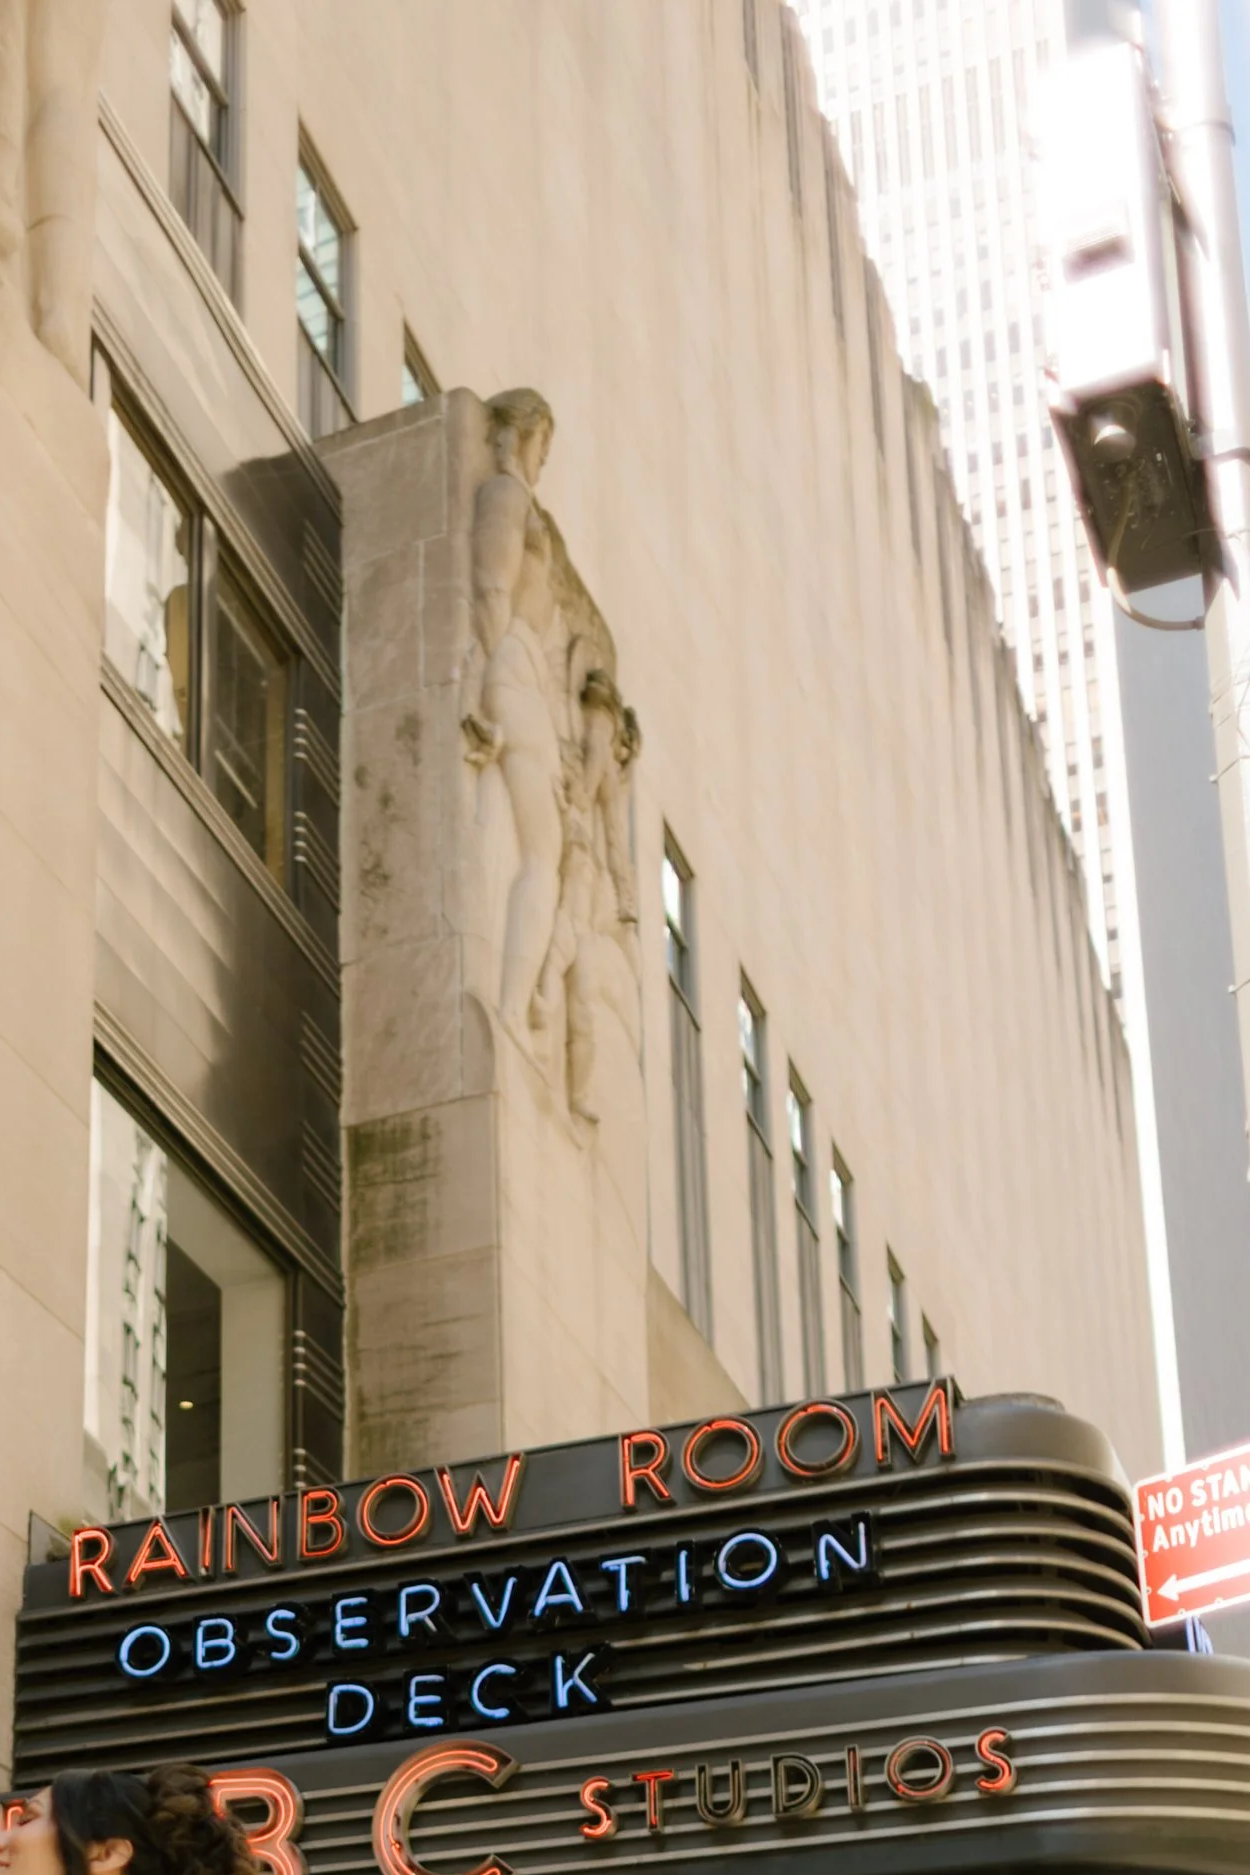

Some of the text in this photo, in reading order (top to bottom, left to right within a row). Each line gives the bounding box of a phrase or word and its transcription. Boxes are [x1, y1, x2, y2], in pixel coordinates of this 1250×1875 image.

[69, 1375, 955, 1598] RAINBOW ROOM
[1147, 1487, 1185, 1521] NO
[117, 1520, 869, 1677] OBSERVATION
[327, 1650, 599, 1737] DECK
[579, 1726, 1017, 1839] STUDIOS
